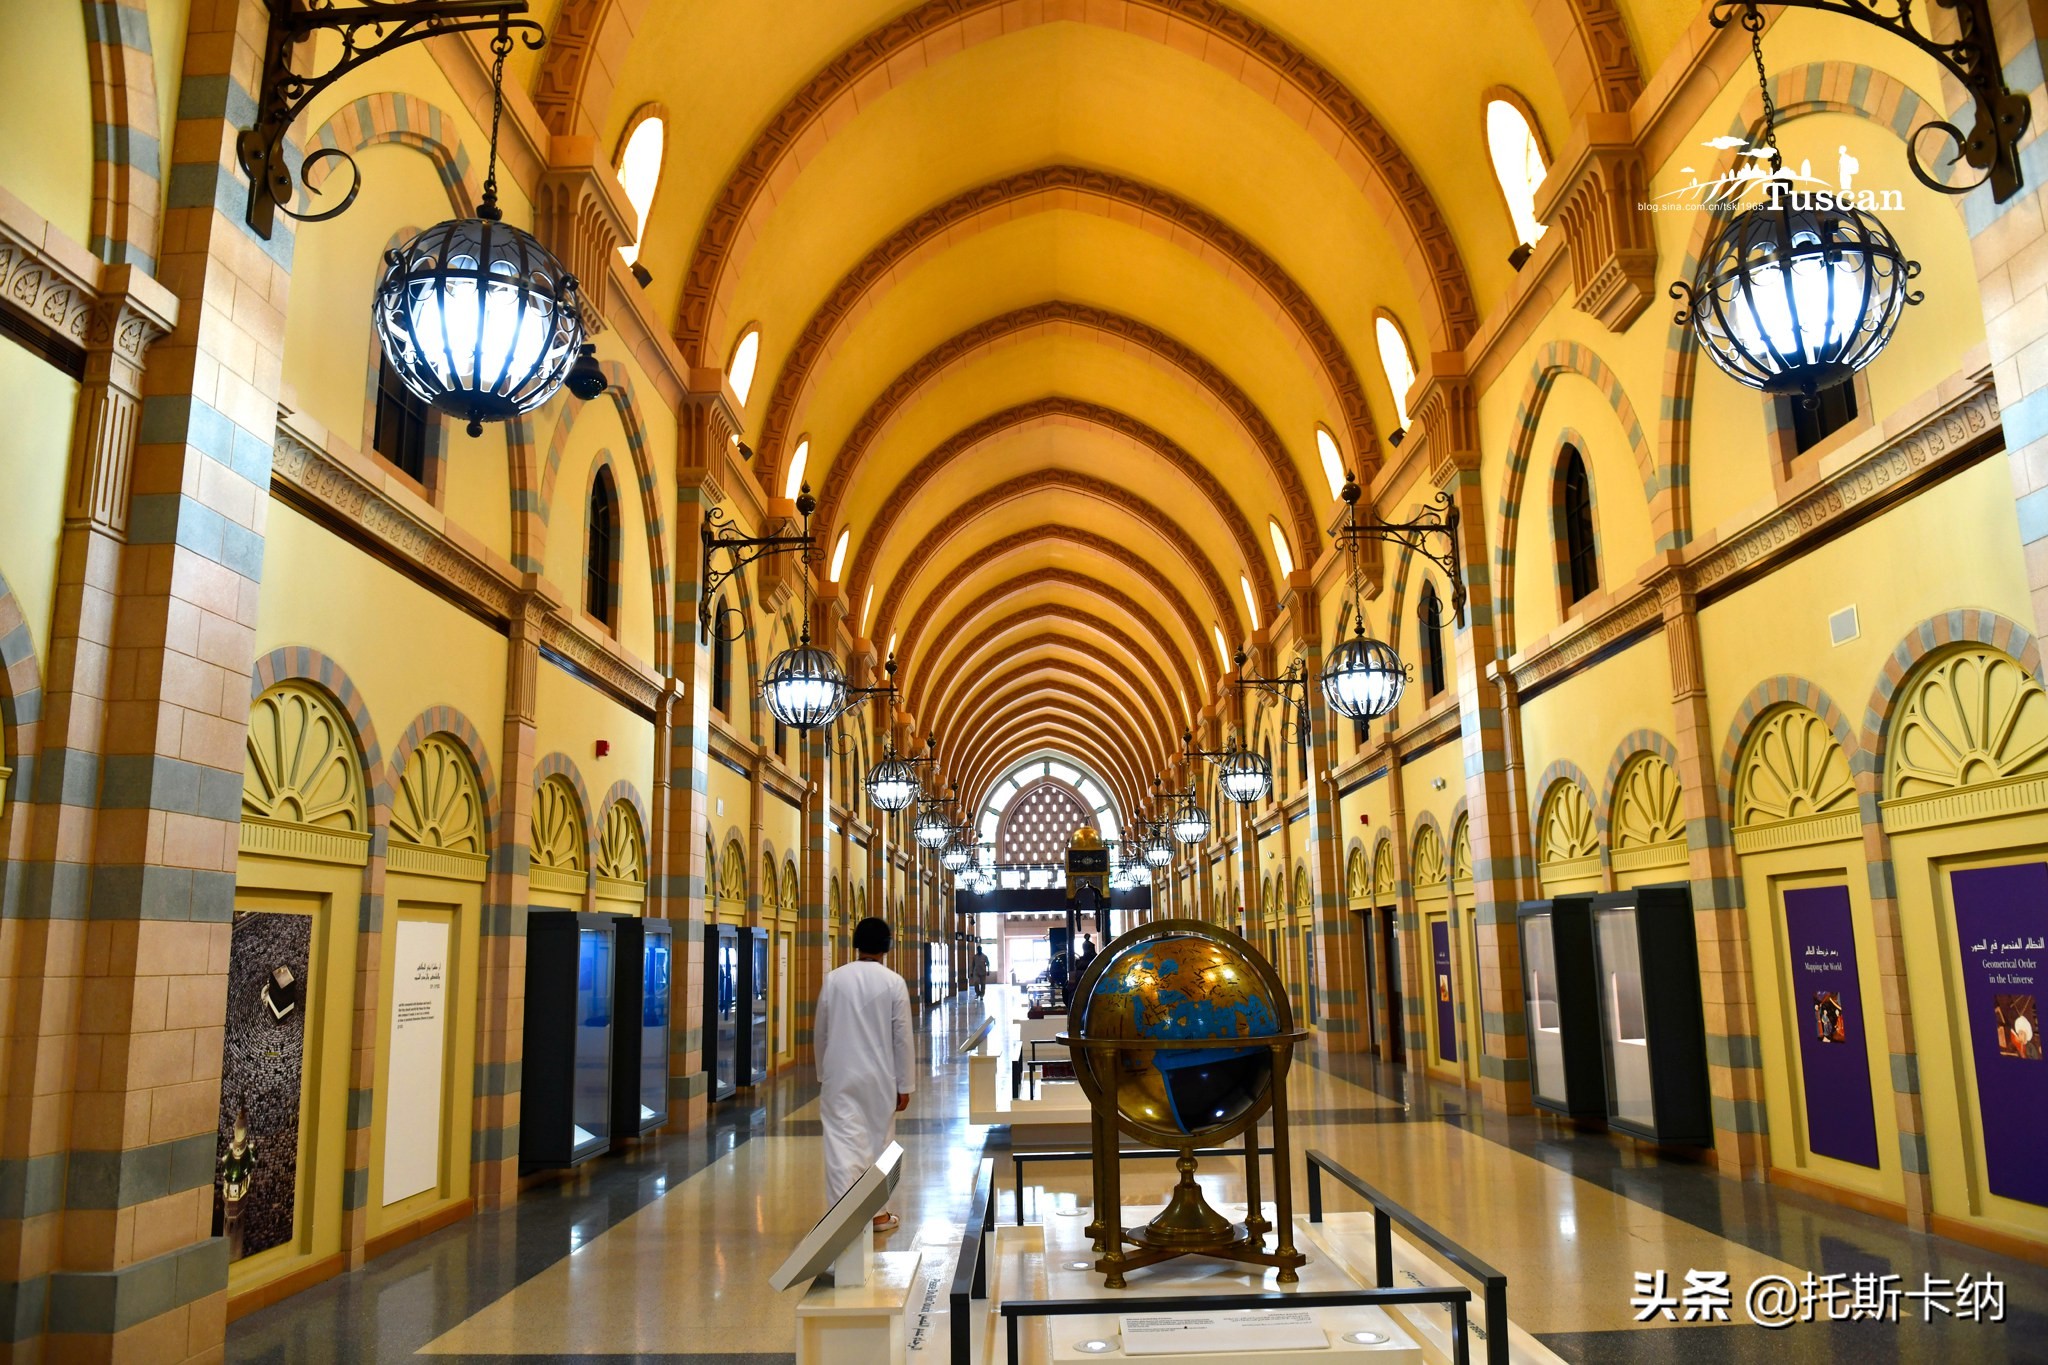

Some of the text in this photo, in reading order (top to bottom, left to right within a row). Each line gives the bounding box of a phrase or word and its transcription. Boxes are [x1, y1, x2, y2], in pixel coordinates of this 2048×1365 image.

[1990, 939, 1998, 954] في
[1804, 962, 1823, 973] Mapping
[1829, 962, 1842, 971] World
[1982, 958, 2037, 969] Geometrical Order
[1989, 973, 2034, 984] in the Universe
